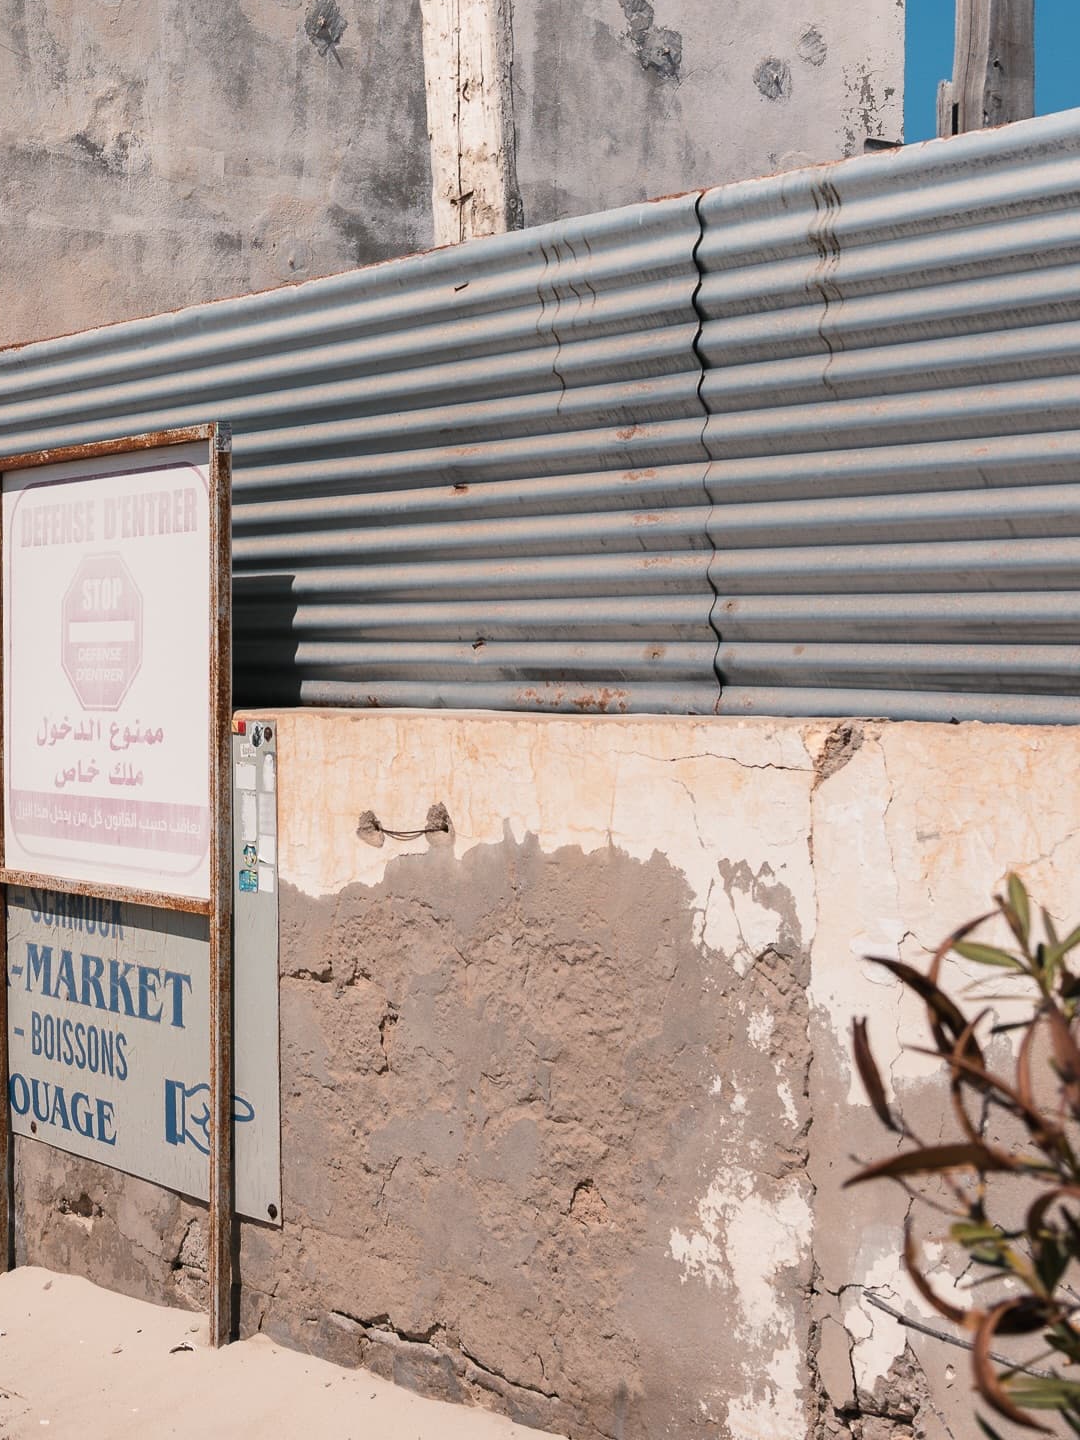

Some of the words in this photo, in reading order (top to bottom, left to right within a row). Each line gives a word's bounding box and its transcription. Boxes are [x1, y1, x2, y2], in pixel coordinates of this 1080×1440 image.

[21, 500, 95, 548] DEFENSE
[104, 488, 198, 540] D'ENTRER
[82, 576, 123, 610] STOP
[36, 716, 101, 746] الدخول
[109, 719, 164, 751] ممنوع
[54, 758, 100, 788] خاص
[108, 761, 144, 786] ملك
[31, 1010, 128, 1081] BOISSONS
